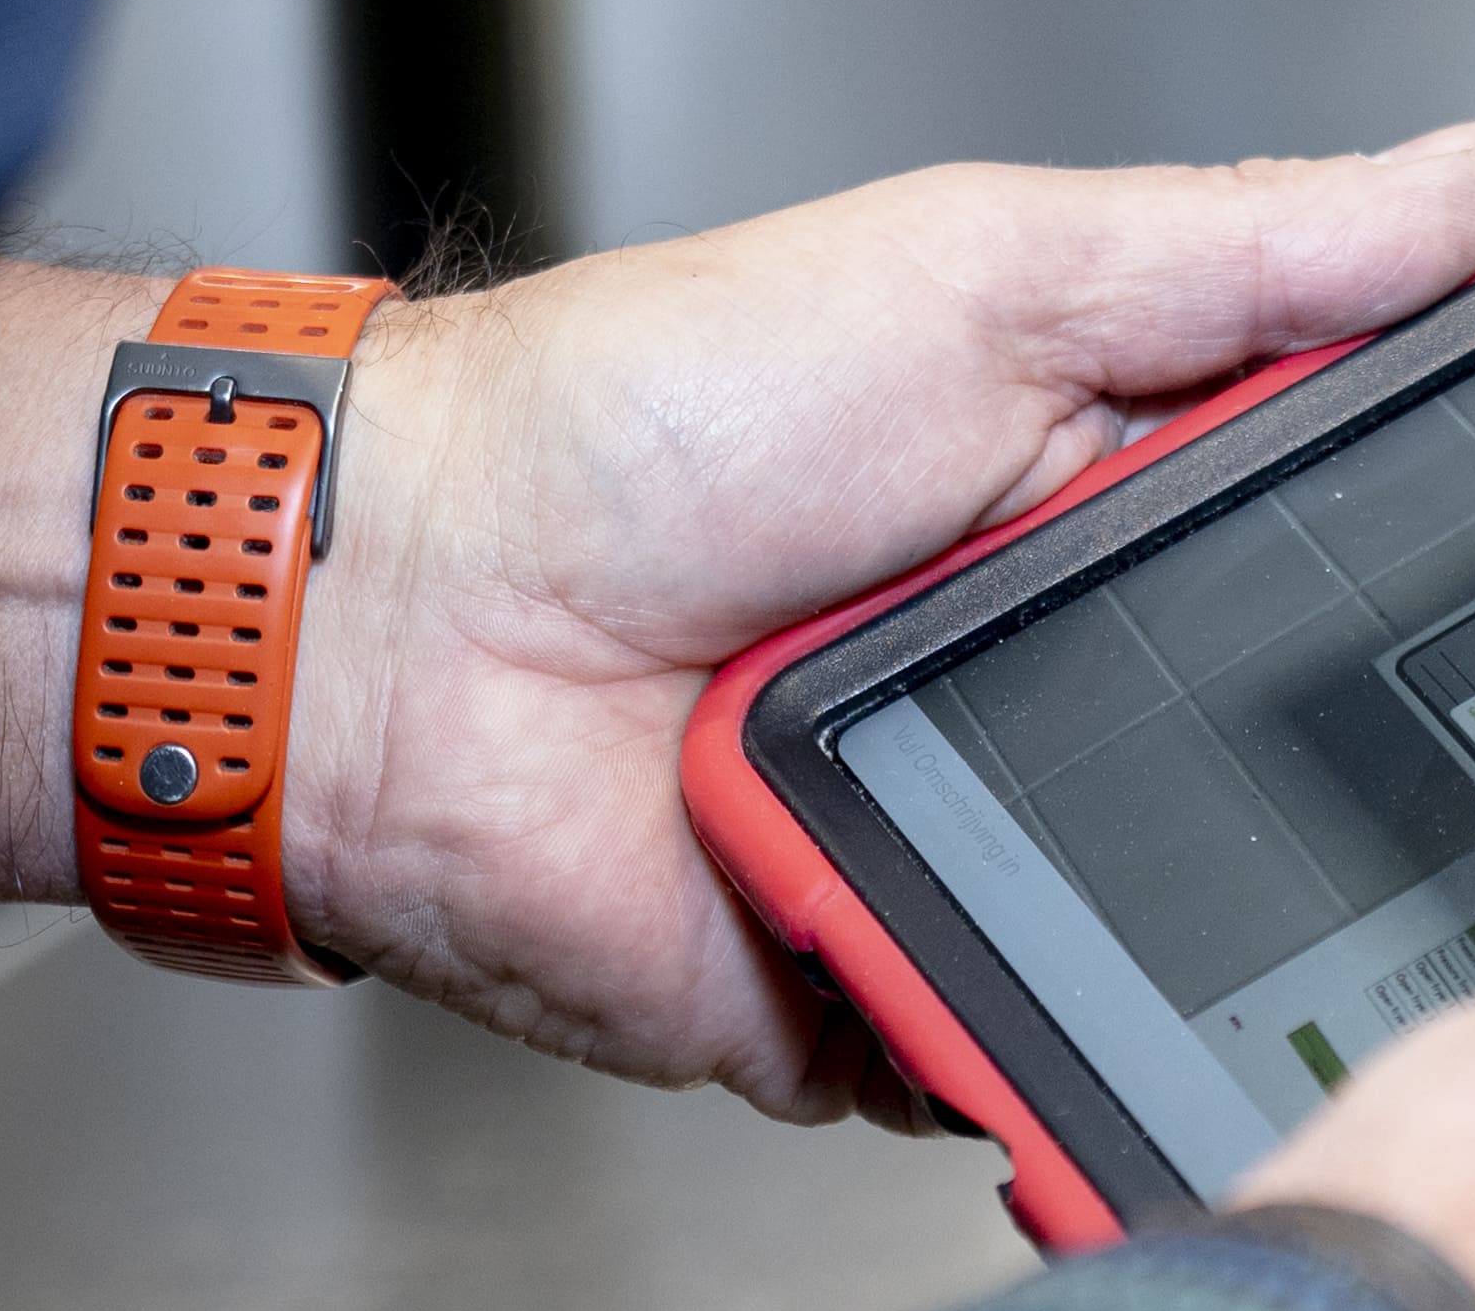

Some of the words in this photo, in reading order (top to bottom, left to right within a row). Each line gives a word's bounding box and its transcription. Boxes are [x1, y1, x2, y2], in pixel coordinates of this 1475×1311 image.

[912, 751, 1008, 862] Omschrijving
[998, 854, 1024, 878] in
[1392, 971, 1418, 997] Open
[1412, 960, 1438, 985] Open
[1372, 983, 1398, 1008] Open
